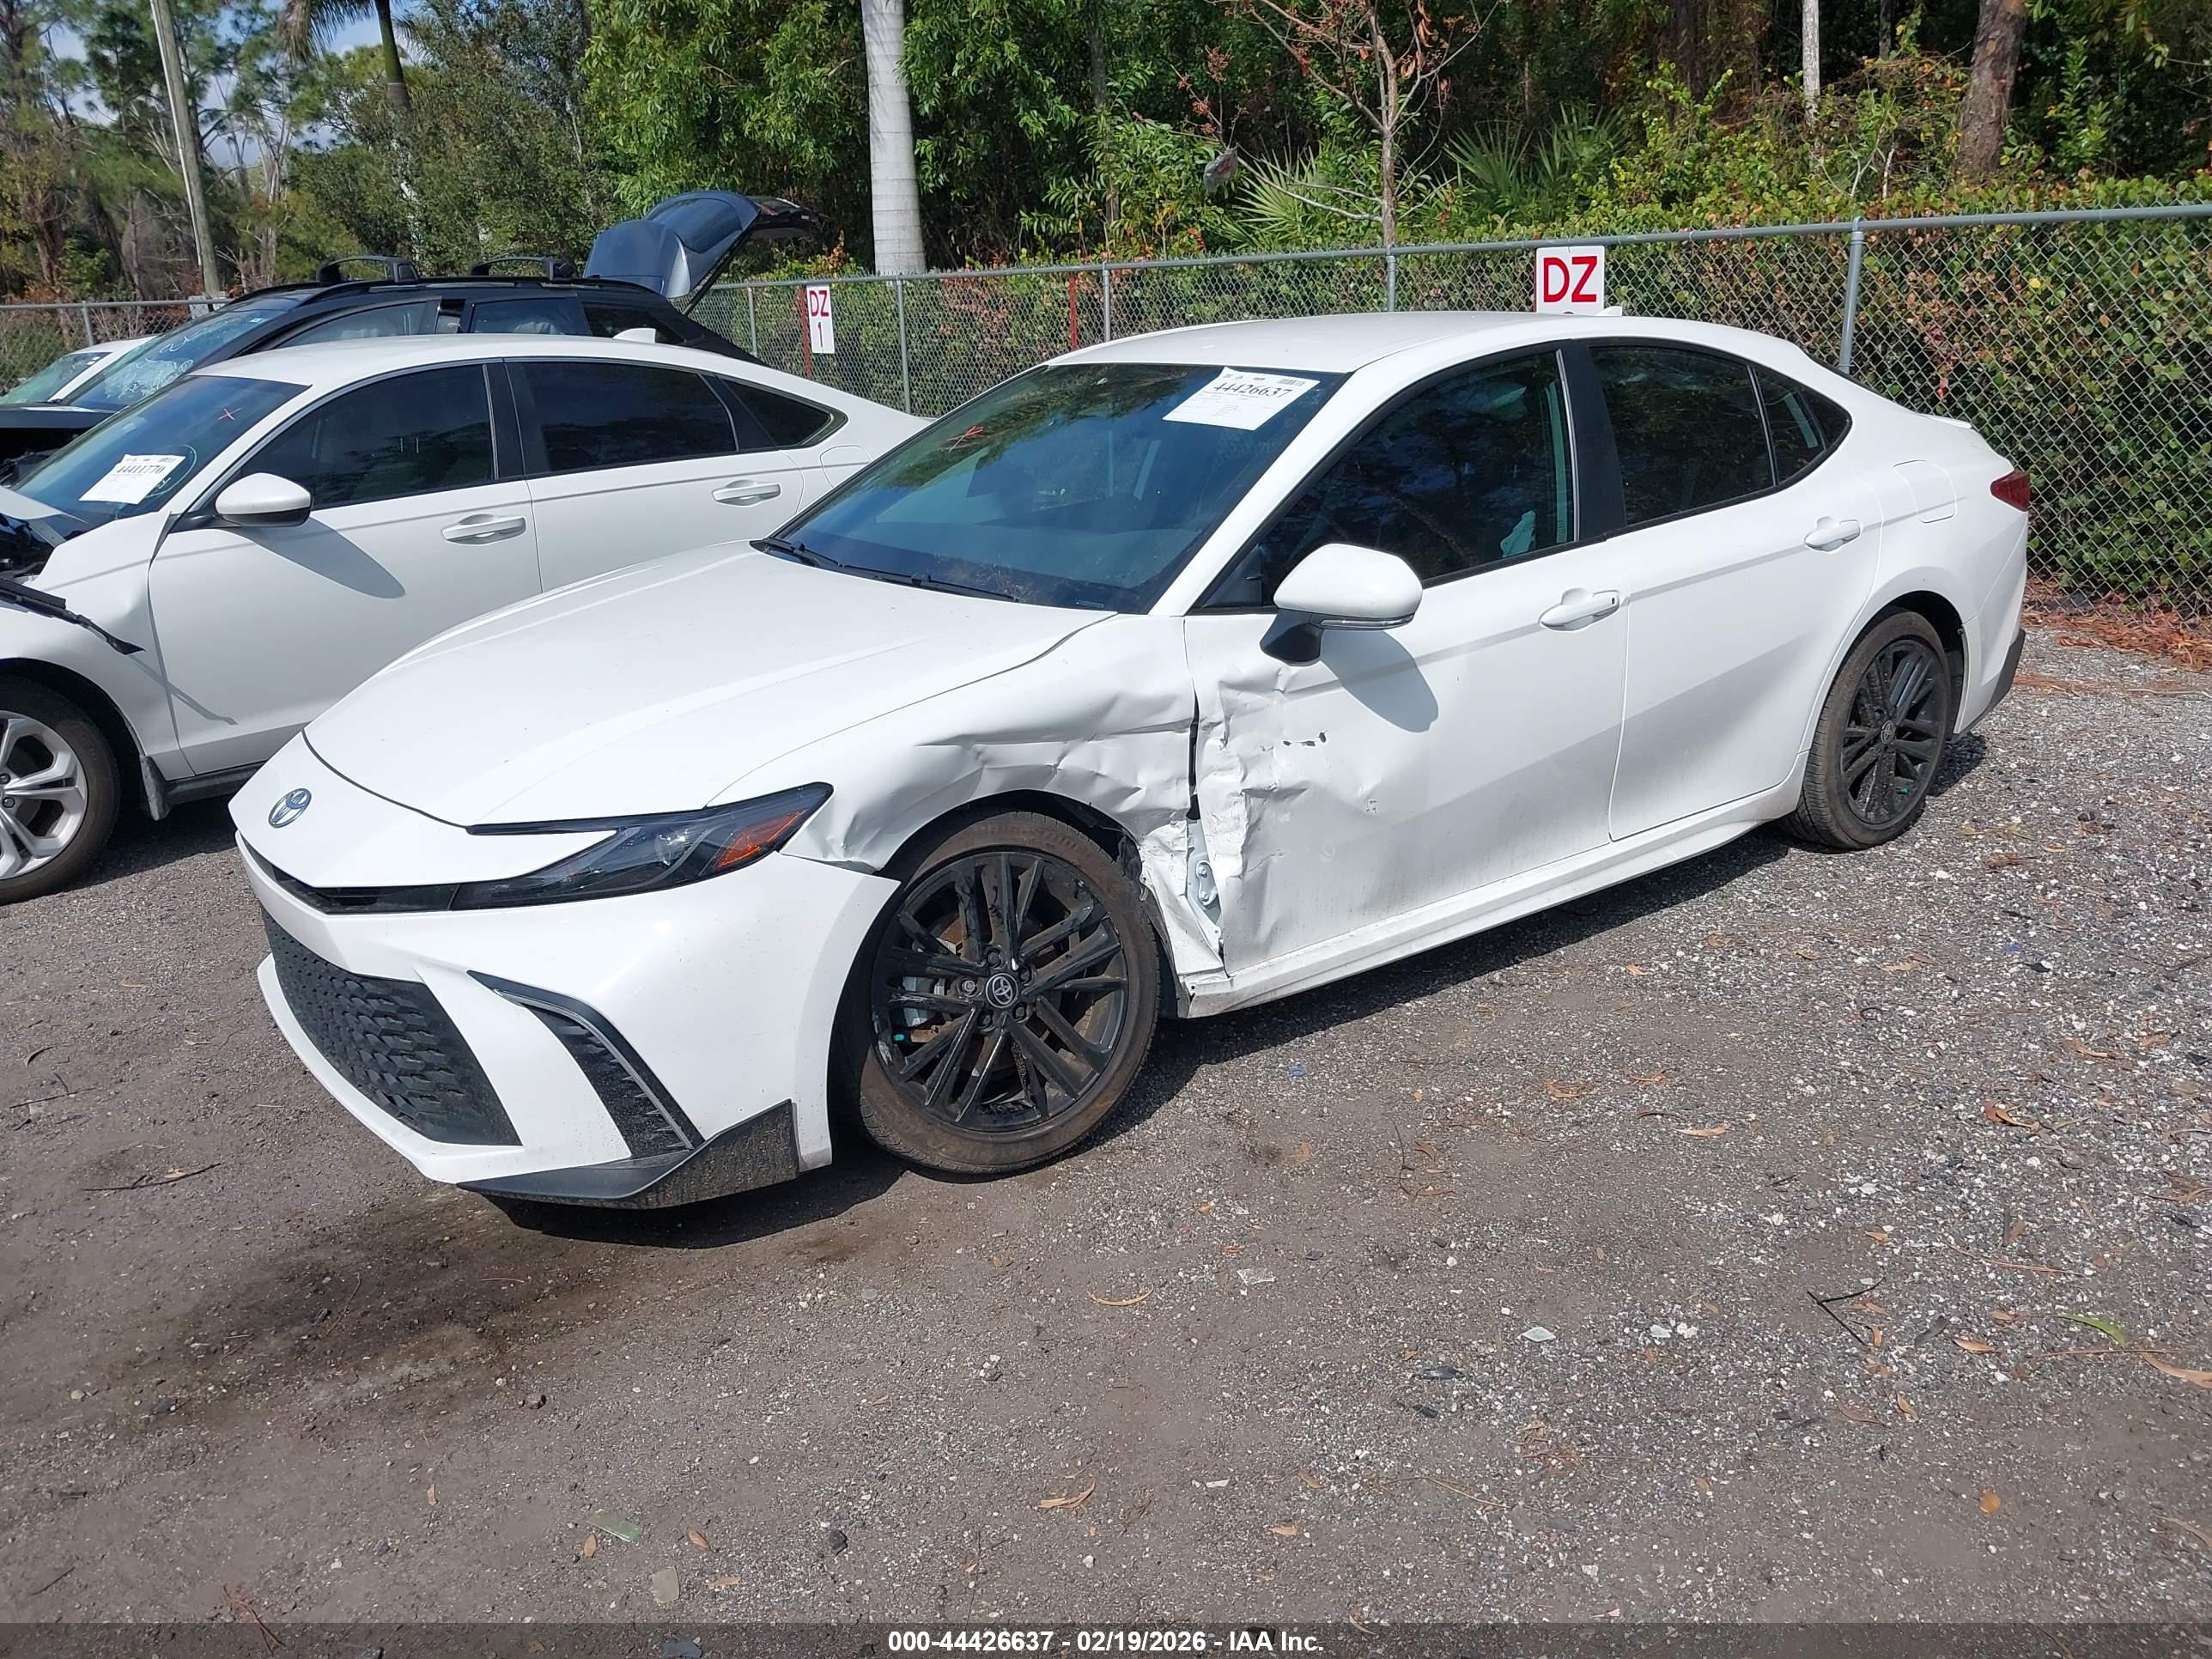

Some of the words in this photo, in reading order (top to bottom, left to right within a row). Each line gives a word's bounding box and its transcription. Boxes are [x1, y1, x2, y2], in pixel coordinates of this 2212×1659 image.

[1543, 256, 1597, 302] DZ
[809, 289, 830, 317] DZ
[817, 321, 823, 348] 1
[1213, 381, 1294, 398] 44426637
[117, 465, 166, 474] 44411770
